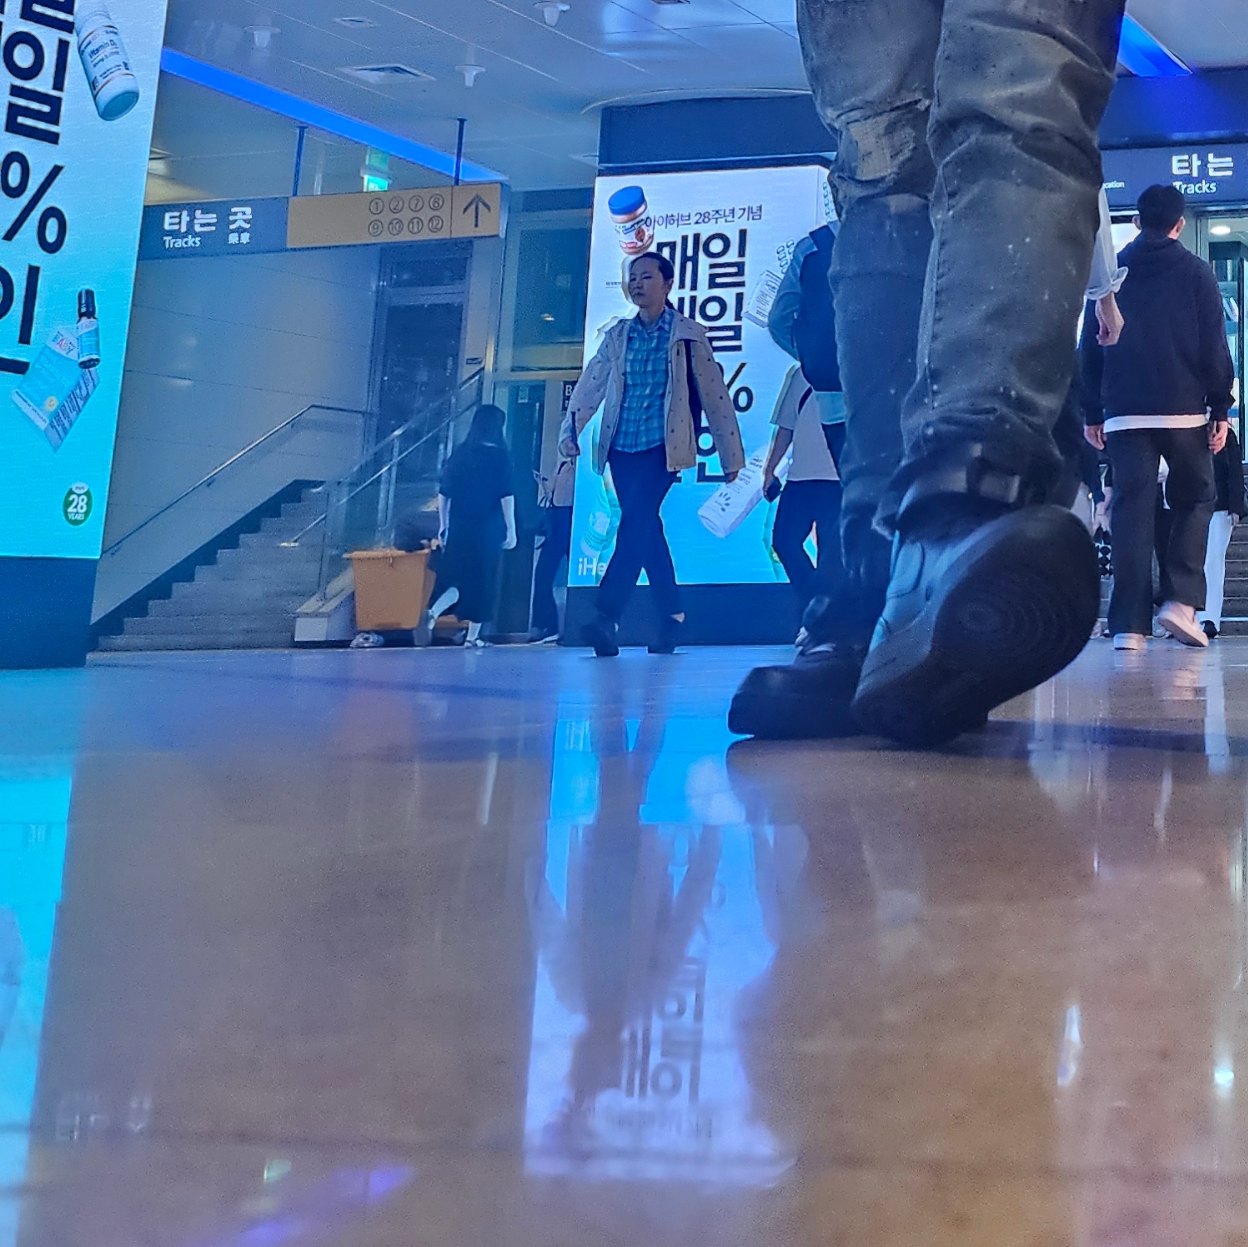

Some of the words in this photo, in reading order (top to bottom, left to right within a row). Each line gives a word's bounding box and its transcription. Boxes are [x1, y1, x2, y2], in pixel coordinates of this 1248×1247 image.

[1172, 152, 1234, 178] 타는
[1172, 179, 1217, 195] Tracks
[163, 209, 218, 233] 타는
[228, 206, 252, 230] 곳
[645, 212, 692, 230] 아이허브
[694, 206, 736, 226] 28주년
[738, 203, 763, 221] 기념
[163, 235, 201, 249] Tracks
[67, 493, 88, 513] 28
